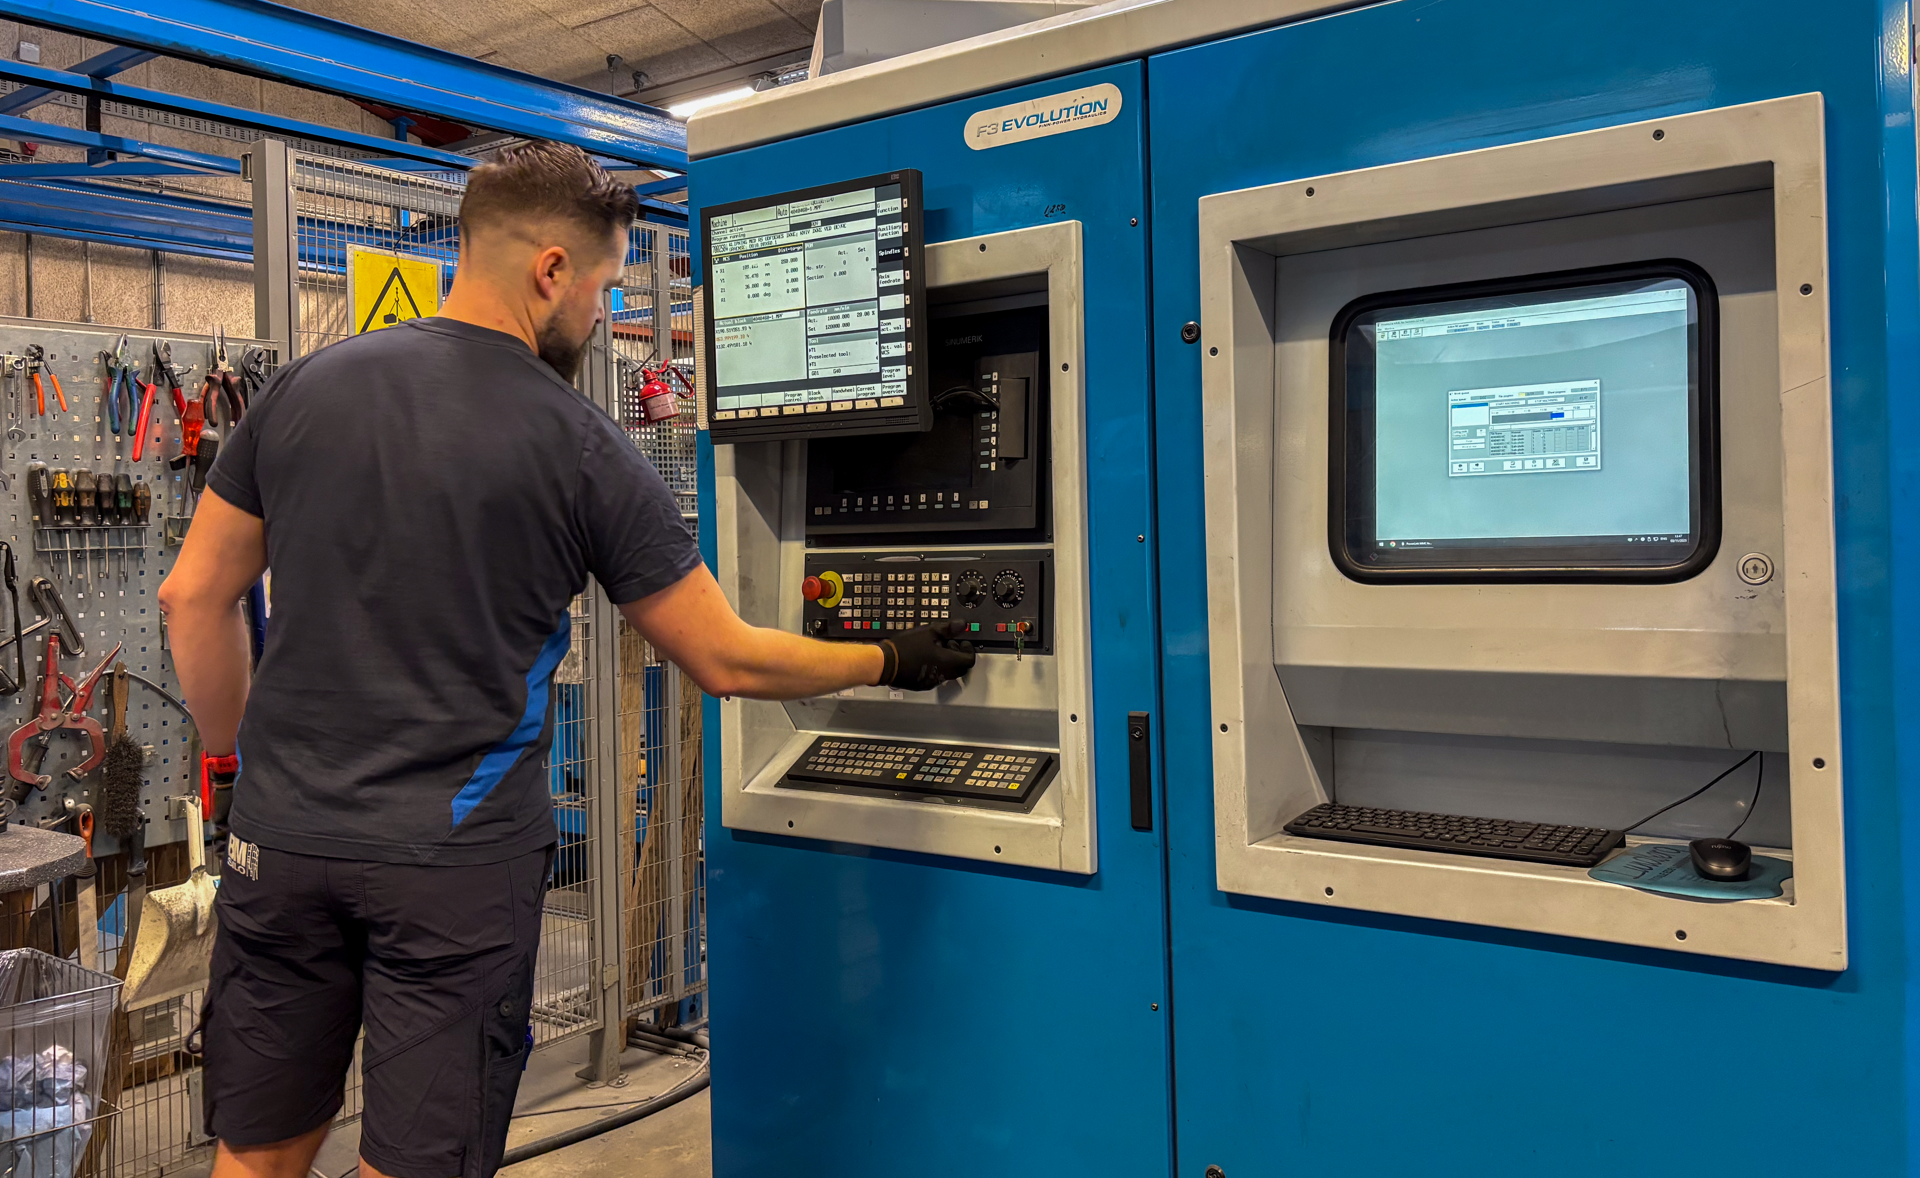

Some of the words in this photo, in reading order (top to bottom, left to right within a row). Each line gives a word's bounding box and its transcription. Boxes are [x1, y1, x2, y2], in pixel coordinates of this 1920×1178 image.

[976, 123, 999, 138] F3
[1001, 98, 1108, 132] EVOLUTION
[1039, 119, 1071, 129] FINN-POWER
[1073, 111, 1107, 121] HYDRAULICS
[879, 249, 901, 257] Spindles
[945, 335, 983, 346] SINUMERIK
[809, 352, 836, 360] Preselected
[228, 832, 248, 867] BM
